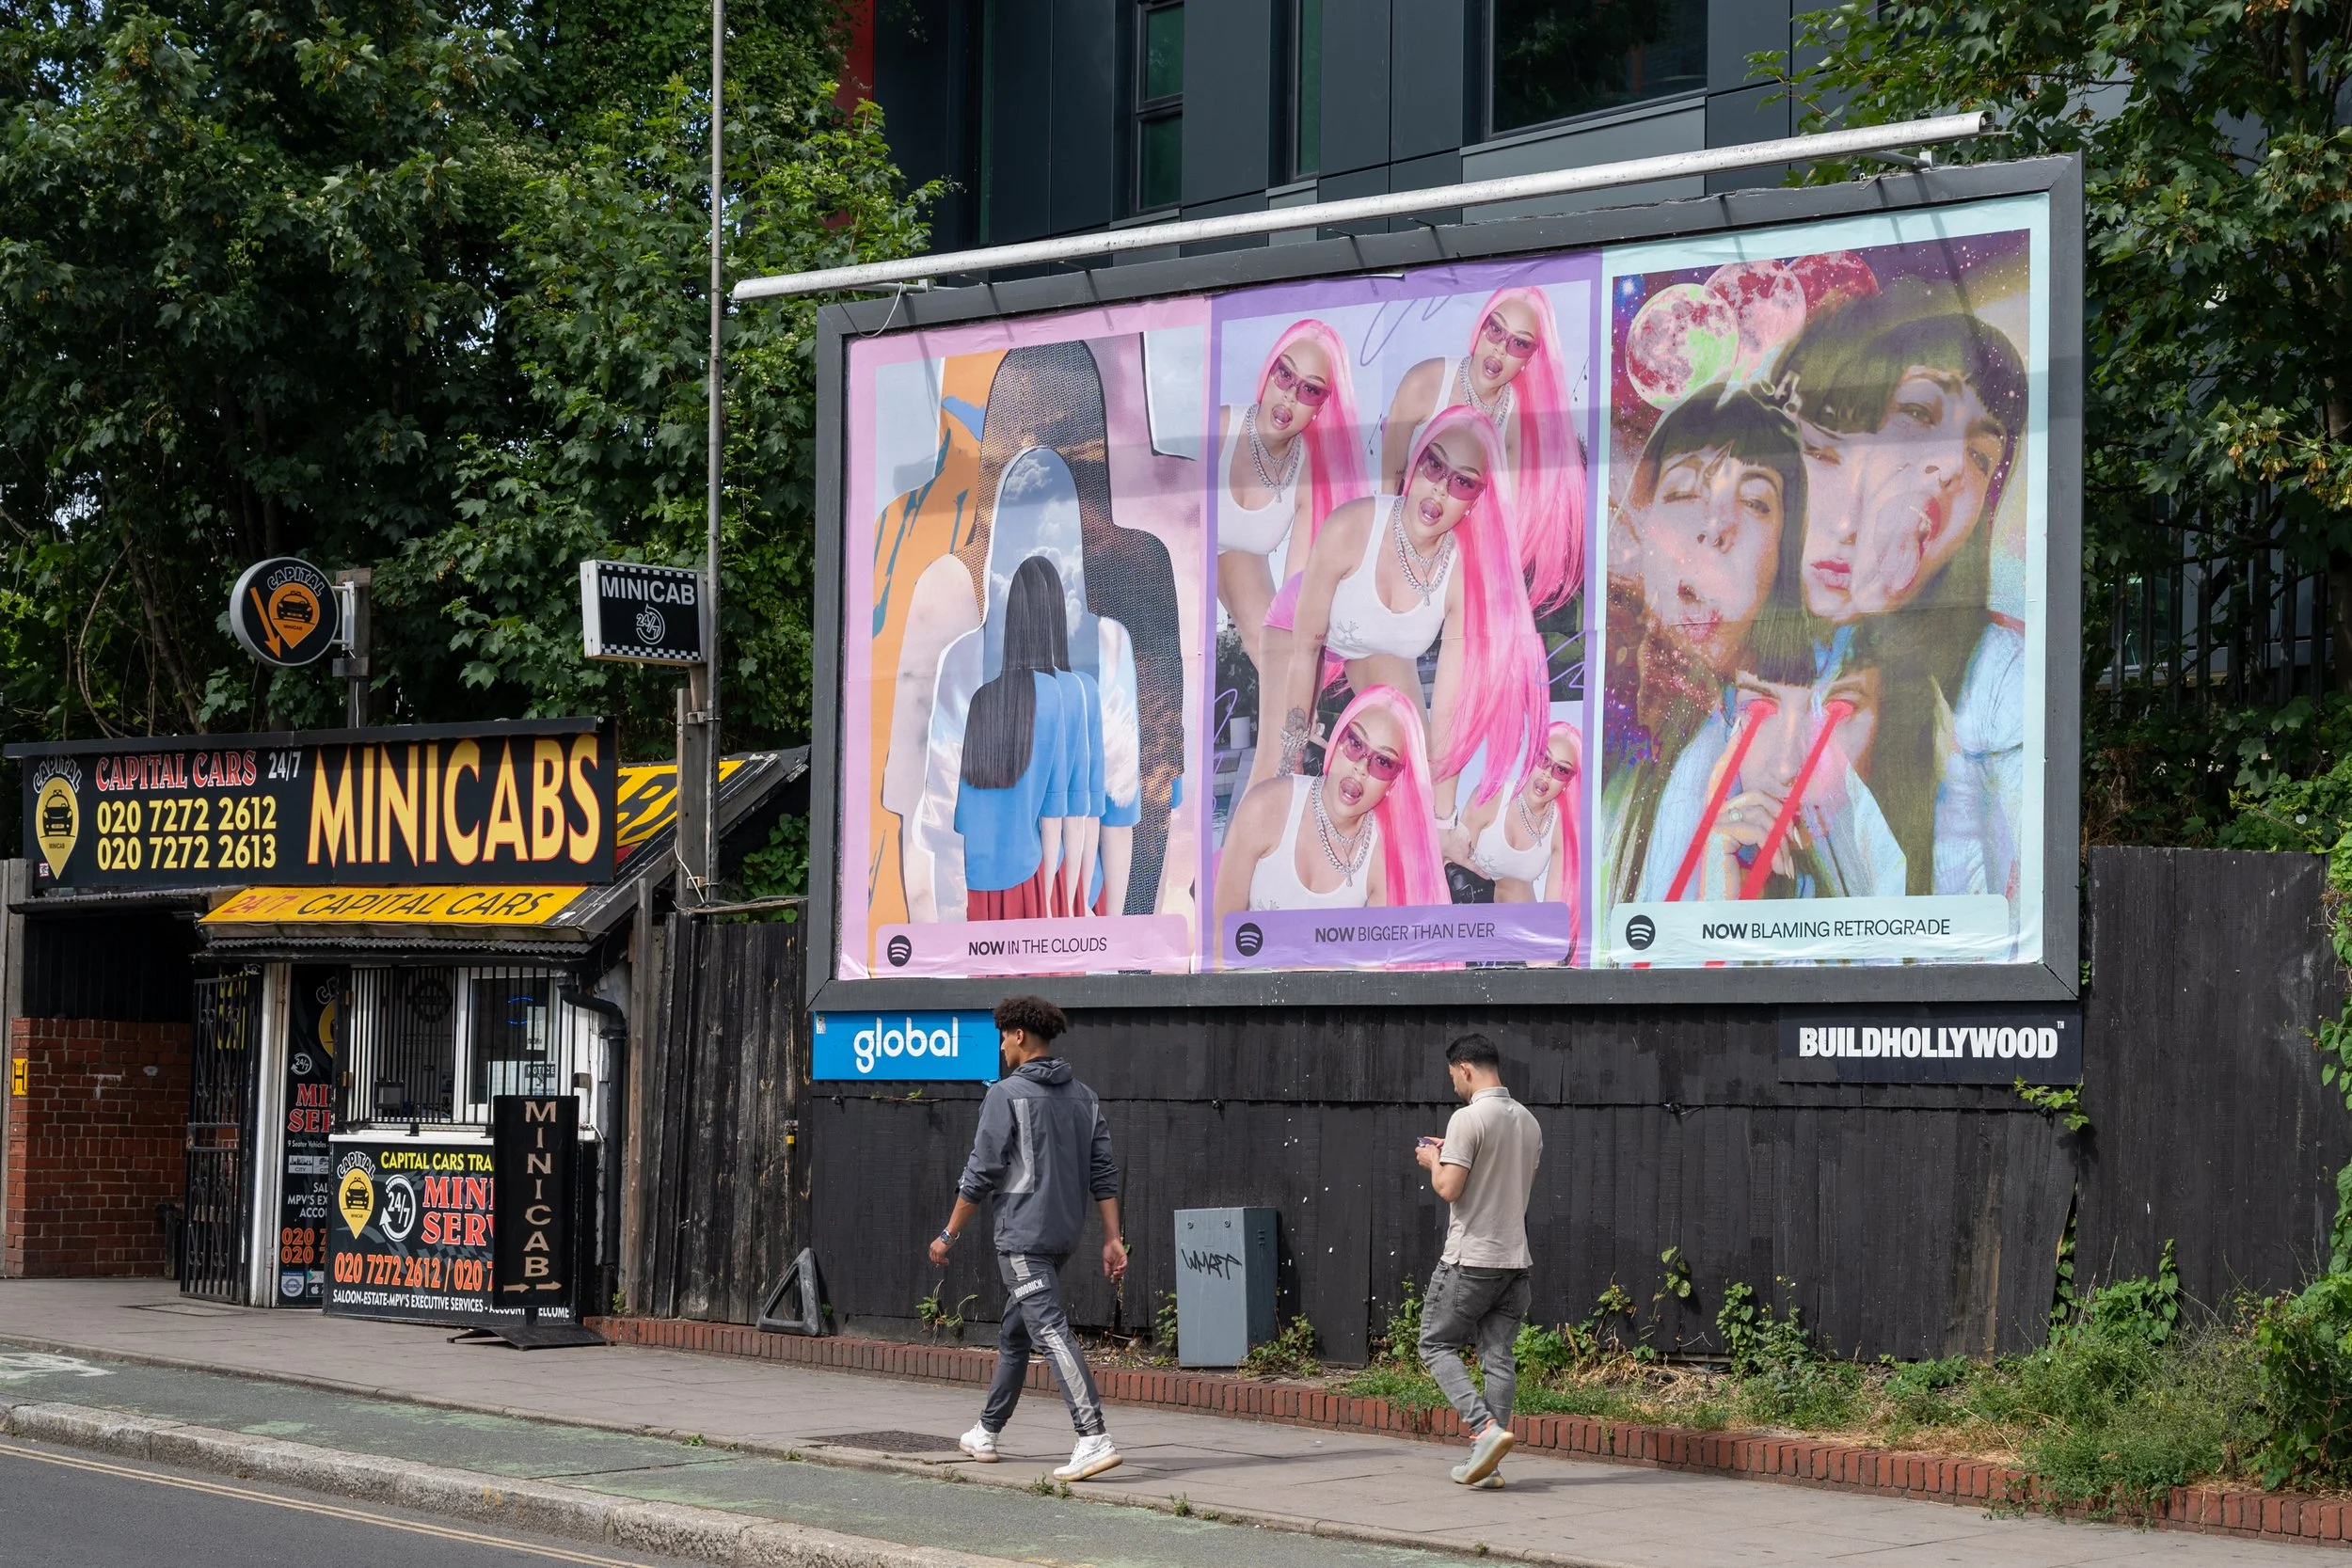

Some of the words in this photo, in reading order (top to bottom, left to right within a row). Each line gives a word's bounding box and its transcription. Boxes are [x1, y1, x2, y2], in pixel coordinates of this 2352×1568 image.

[267, 566, 325, 597] CAPITAL
[601, 575, 695, 606] MINICAB
[636, 613, 660, 639] 24/7
[33, 754, 83, 794] CAPITAL
[96, 753, 187, 791] CAPITAL
[193, 750, 257, 787] CARS
[268, 751, 301, 782] 24/7
[97, 800, 141, 834] 020
[149, 798, 210, 832] 7272
[217, 796, 277, 831] 2612
[307, 734, 600, 868] MINICABS
[97, 836, 141, 870] 020
[149, 835, 210, 869] 7272
[217, 833, 277, 868] 2613
[297, 894, 446, 915] CAPITAL
[445, 893, 554, 916] CARS
[1315, 927, 1355, 942] NOW
[1358, 926, 1408, 942] BIGGER
[1411, 923, 1454, 940] THAN
[1457, 922, 1495, 939] EVER
[1702, 923, 1747, 940] NOW
[1752, 920, 1830, 939] BLAMING
[1835, 918, 1950, 937] RETROGRADE
[968, 941, 1005, 956] NOW
[1008, 941, 1020, 955] IN
[1023, 939, 1048, 954] THE
[1051, 937, 1107, 953] CLOUDS
[853, 1017, 959, 1073] global
[1799, 1026, 2058, 1059] BUILDHOLLYWOOD
[337, 1151, 375, 1180] CAPITAL
[380, 1151, 430, 1169] CAPITAL
[433, 1153, 464, 1171] CARS
[468, 1154, 494, 1171] TRA
[287, 1195, 314, 1205] MPV'S
[524, 1101, 556, 1277] MINICAB
[299, 1208, 327, 1218] ACCO
[388, 1191, 410, 1227] 24/7
[281, 1227, 315, 1245] 020
[280, 1245, 314, 1264] 020
[334, 1252, 363, 1284] 020
[366, 1254, 401, 1286] 7272
[405, 1256, 440, 1289] 2612
[453, 1259, 483, 1291] 020
[411, 1294, 449, 1310] EXECUTIVE
[451, 1297, 483, 1312] SERVICES
